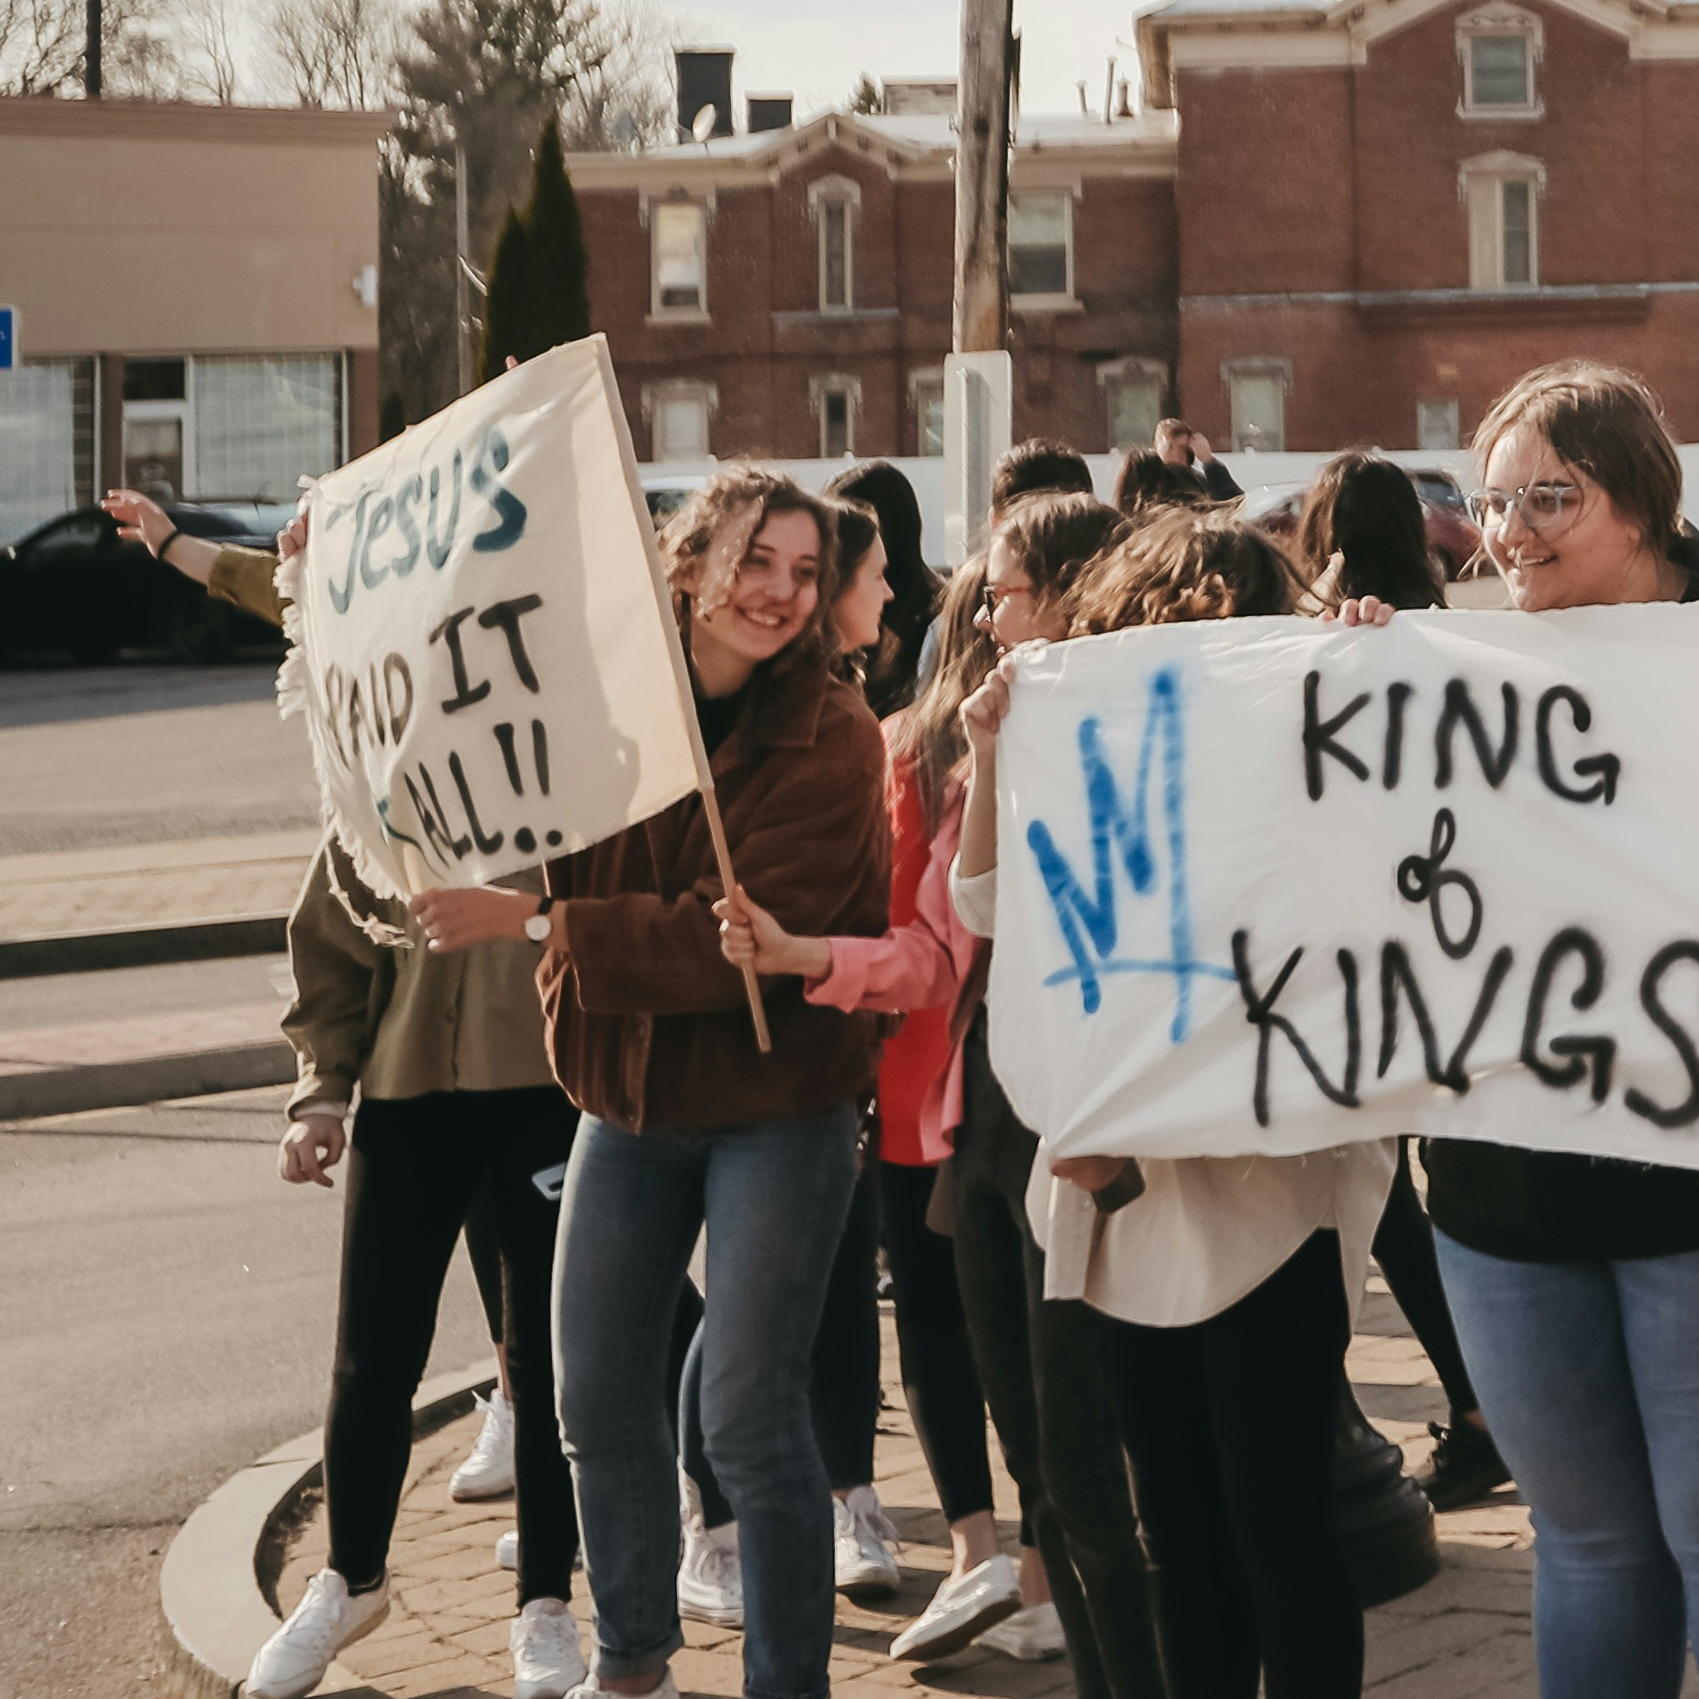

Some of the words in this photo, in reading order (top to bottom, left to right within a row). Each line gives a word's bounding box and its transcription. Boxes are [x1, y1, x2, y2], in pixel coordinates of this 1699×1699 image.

[429, 594, 542, 714] IT
[1302, 668, 1621, 806] KING
[1398, 808, 1484, 960] of
